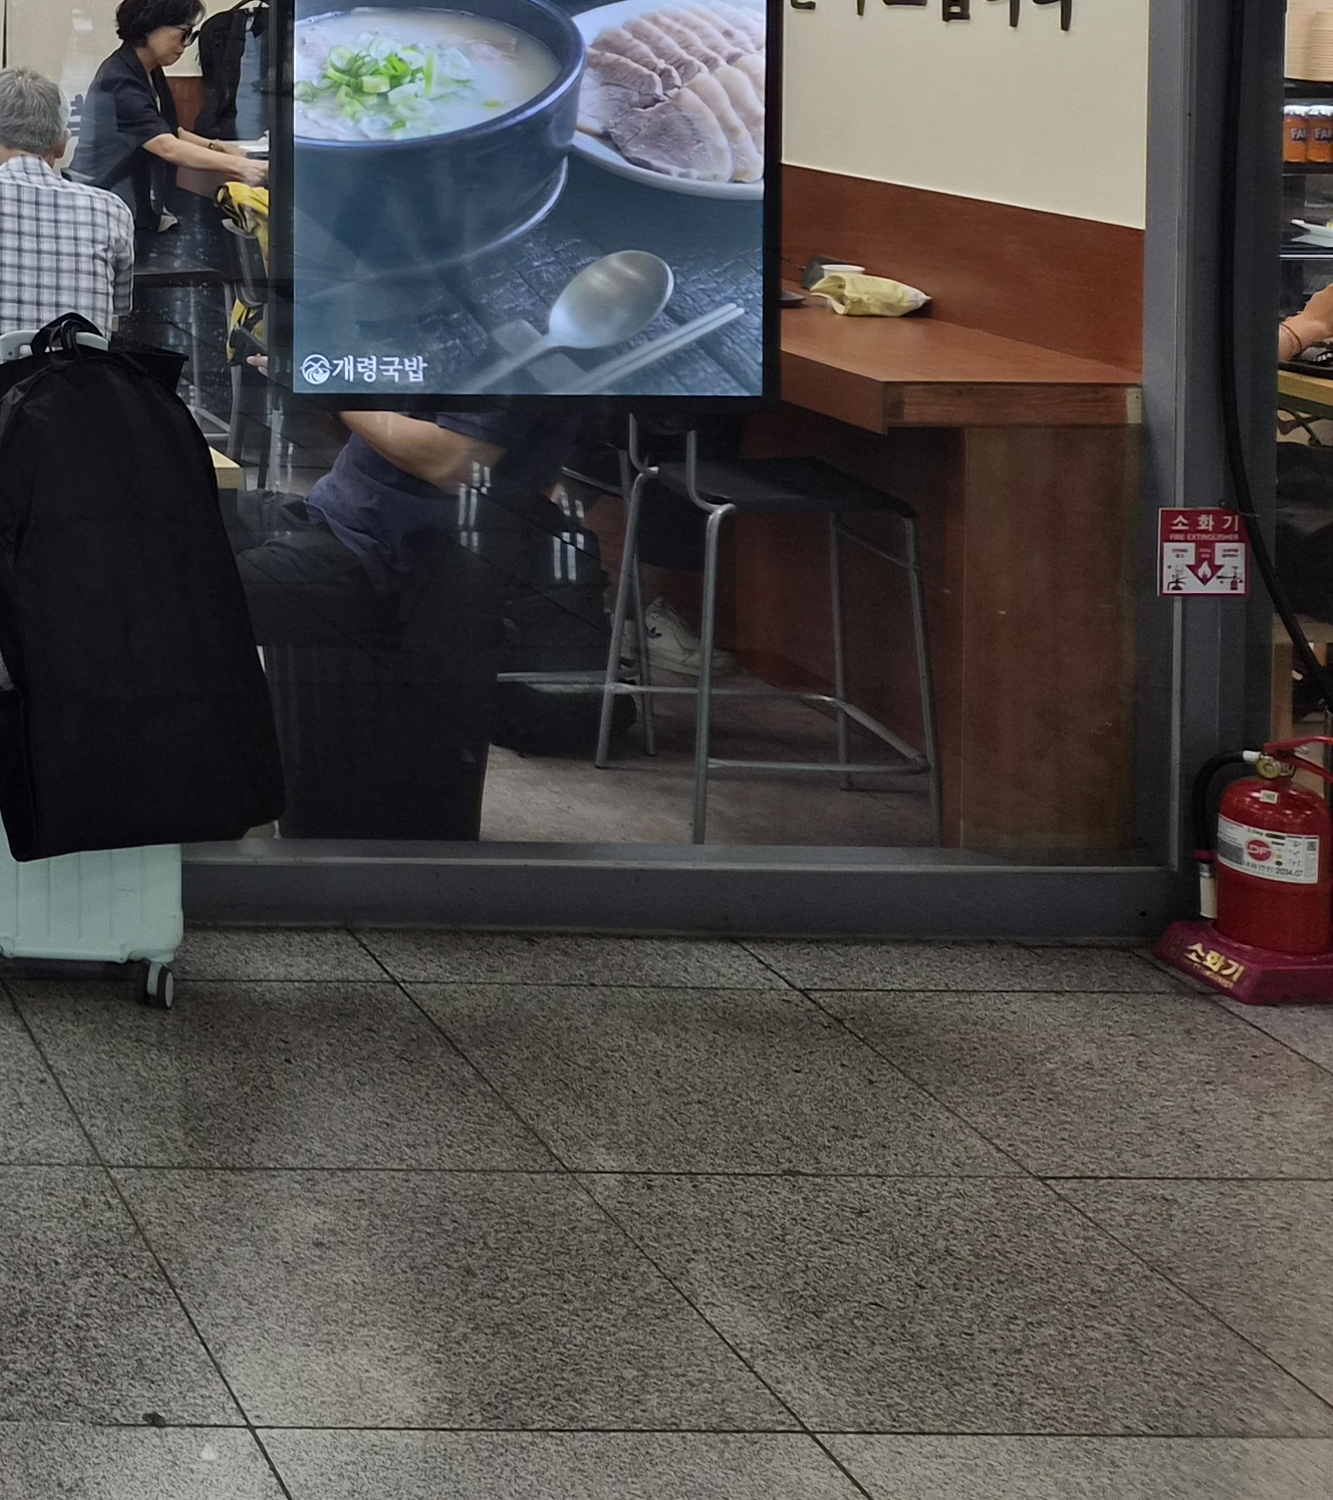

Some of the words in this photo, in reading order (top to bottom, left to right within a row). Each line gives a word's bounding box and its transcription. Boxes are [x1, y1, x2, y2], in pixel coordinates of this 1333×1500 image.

[332, 355, 428, 384] 개령국밥
[1171, 514, 1240, 532] 소화기
[1169, 533, 1185, 541] FIRE
[1187, 533, 1240, 541] EXTINGUISHER
[1183, 941, 1245, 983] 소화기
